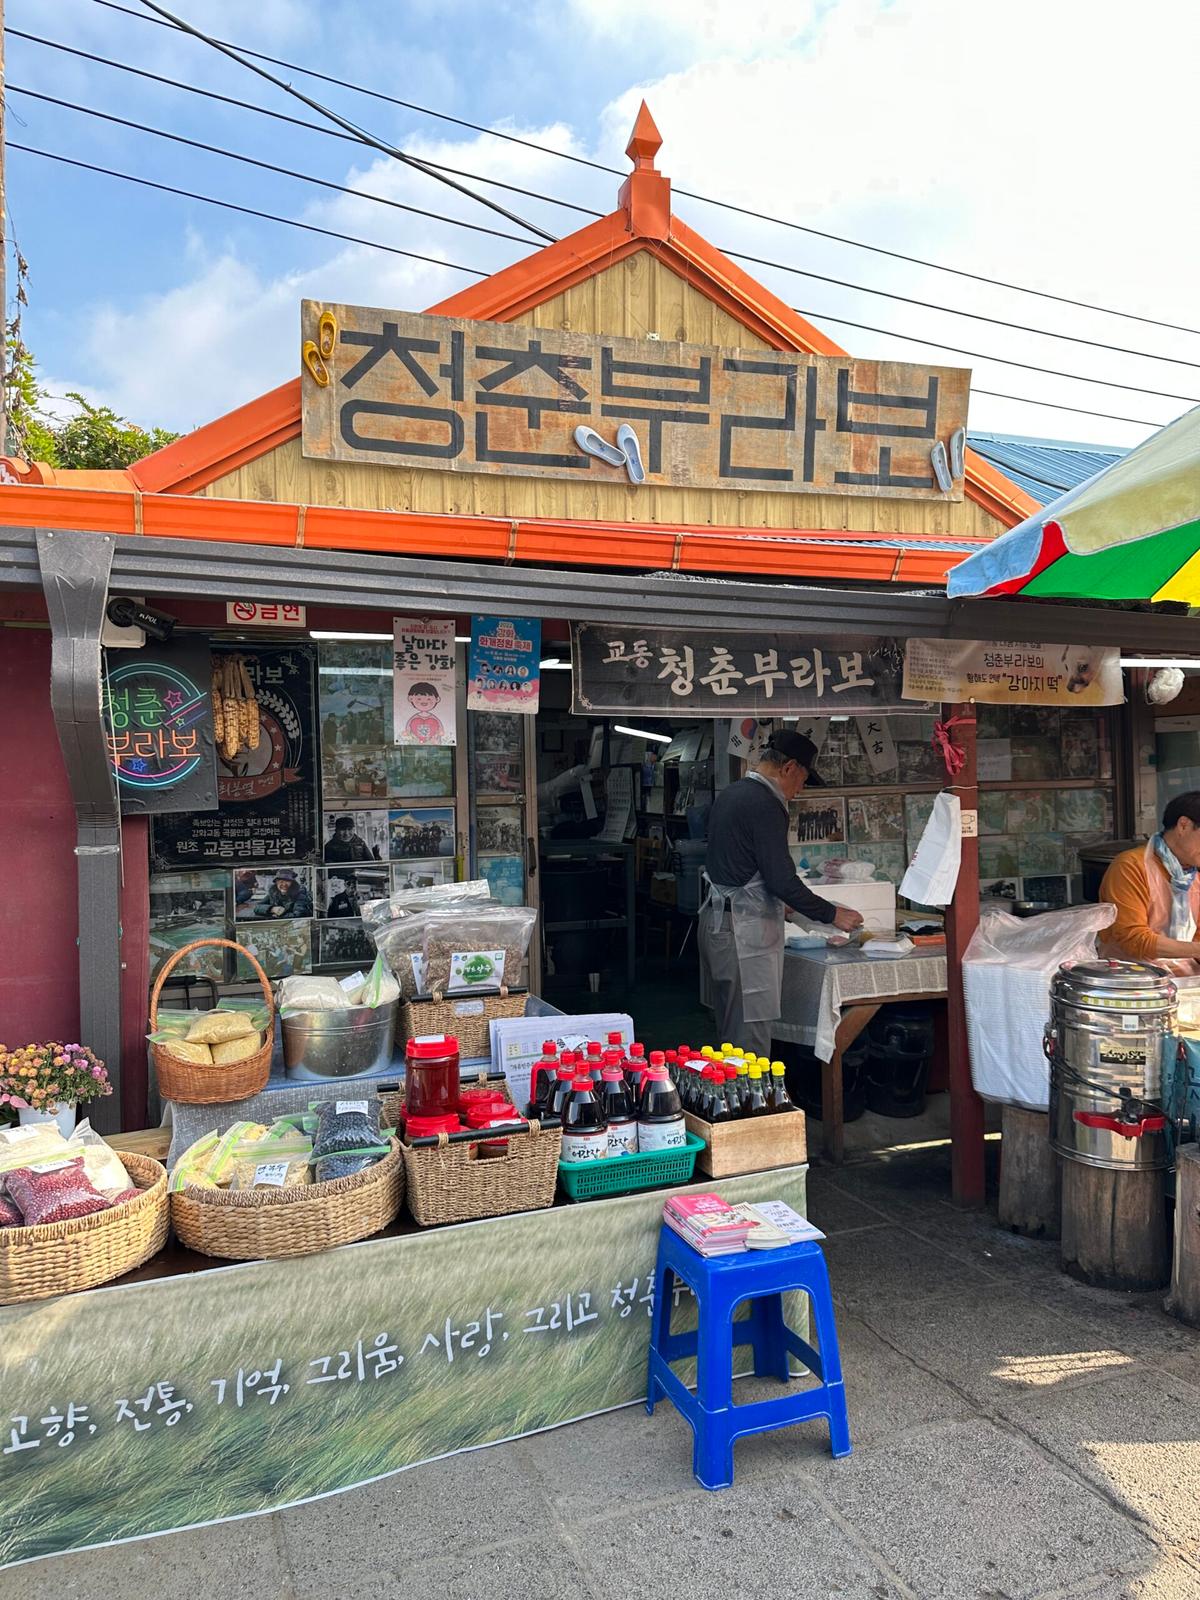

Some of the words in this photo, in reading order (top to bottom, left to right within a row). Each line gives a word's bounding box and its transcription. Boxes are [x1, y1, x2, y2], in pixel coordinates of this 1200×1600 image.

[340, 323, 938, 489] 청춘부라보
[261, 603, 299, 620] 금연
[395, 652, 421, 670] 좋은
[425, 654, 456, 670] 강화
[402, 635, 448, 653] 날마다
[602, 640, 653, 668] 교동
[656, 645, 875, 698] 청춘부라보
[102, 688, 165, 727] 청춘
[106, 729, 200, 766] 부라보
[176, 841, 199, 854] 원조
[203, 838, 296, 857] 교동명물강정
[2, 1405, 98, 1454] 고향,
[115, 1379, 195, 1431] 전통,
[210, 1358, 290, 1407] 기억,
[306, 1332, 405, 1386] 그리움,
[420, 1310, 510, 1362] 사랑,
[522, 1288, 598, 1333] 그리고
